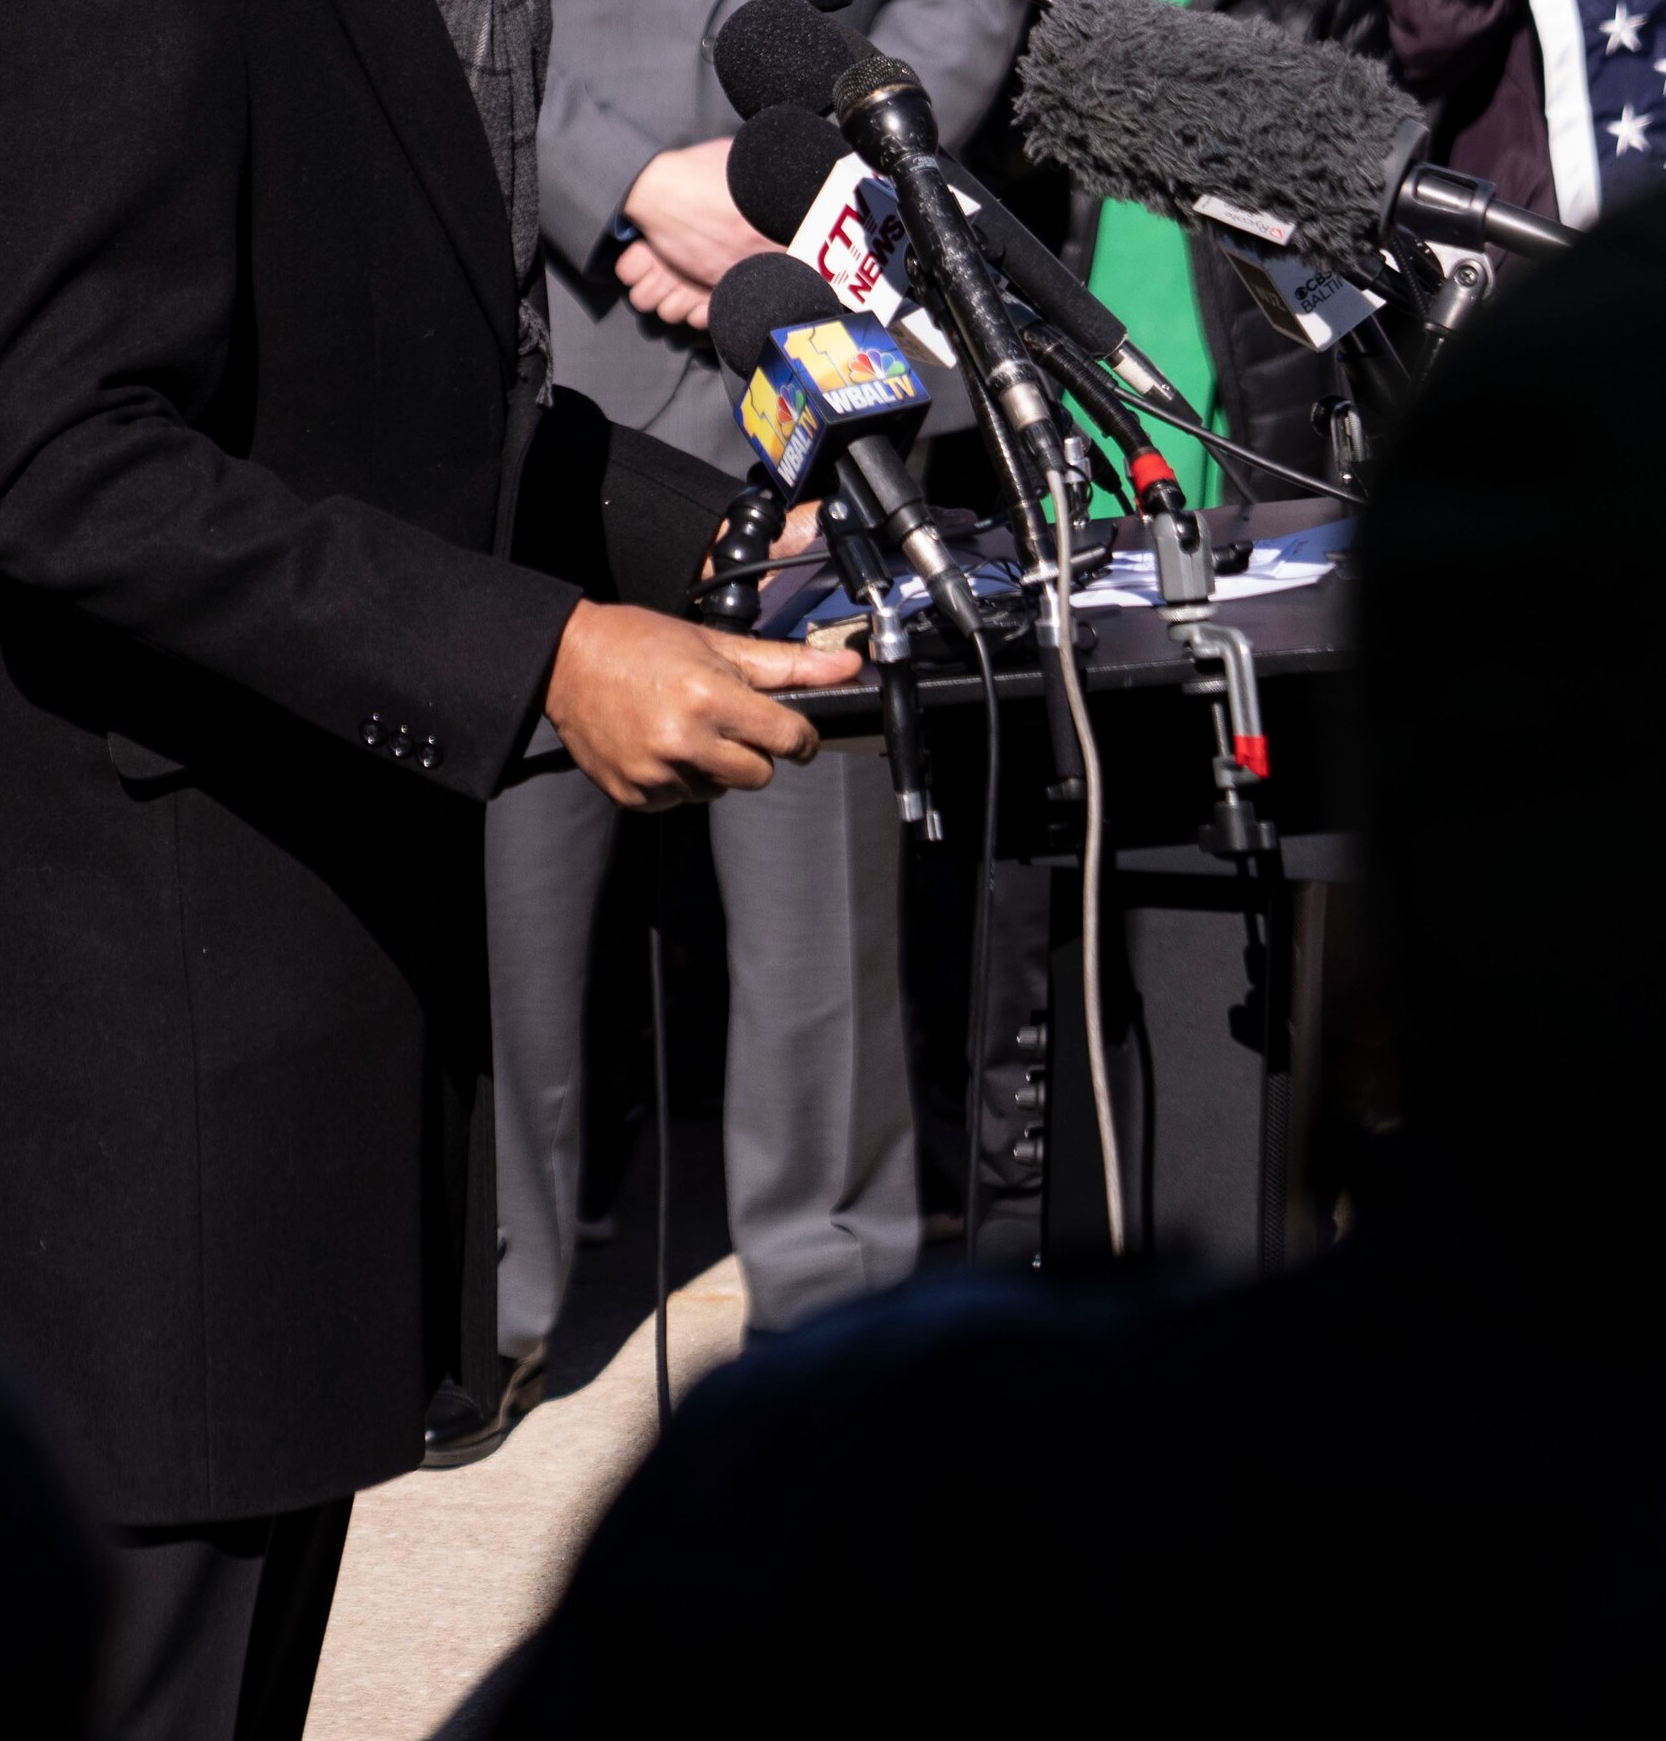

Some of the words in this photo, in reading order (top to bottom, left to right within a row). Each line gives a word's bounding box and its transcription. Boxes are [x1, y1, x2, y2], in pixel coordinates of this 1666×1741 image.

[848, 214, 906, 305] NEWS
[822, 374, 916, 415] WBALTV
[777, 405, 819, 488] WBALTV
